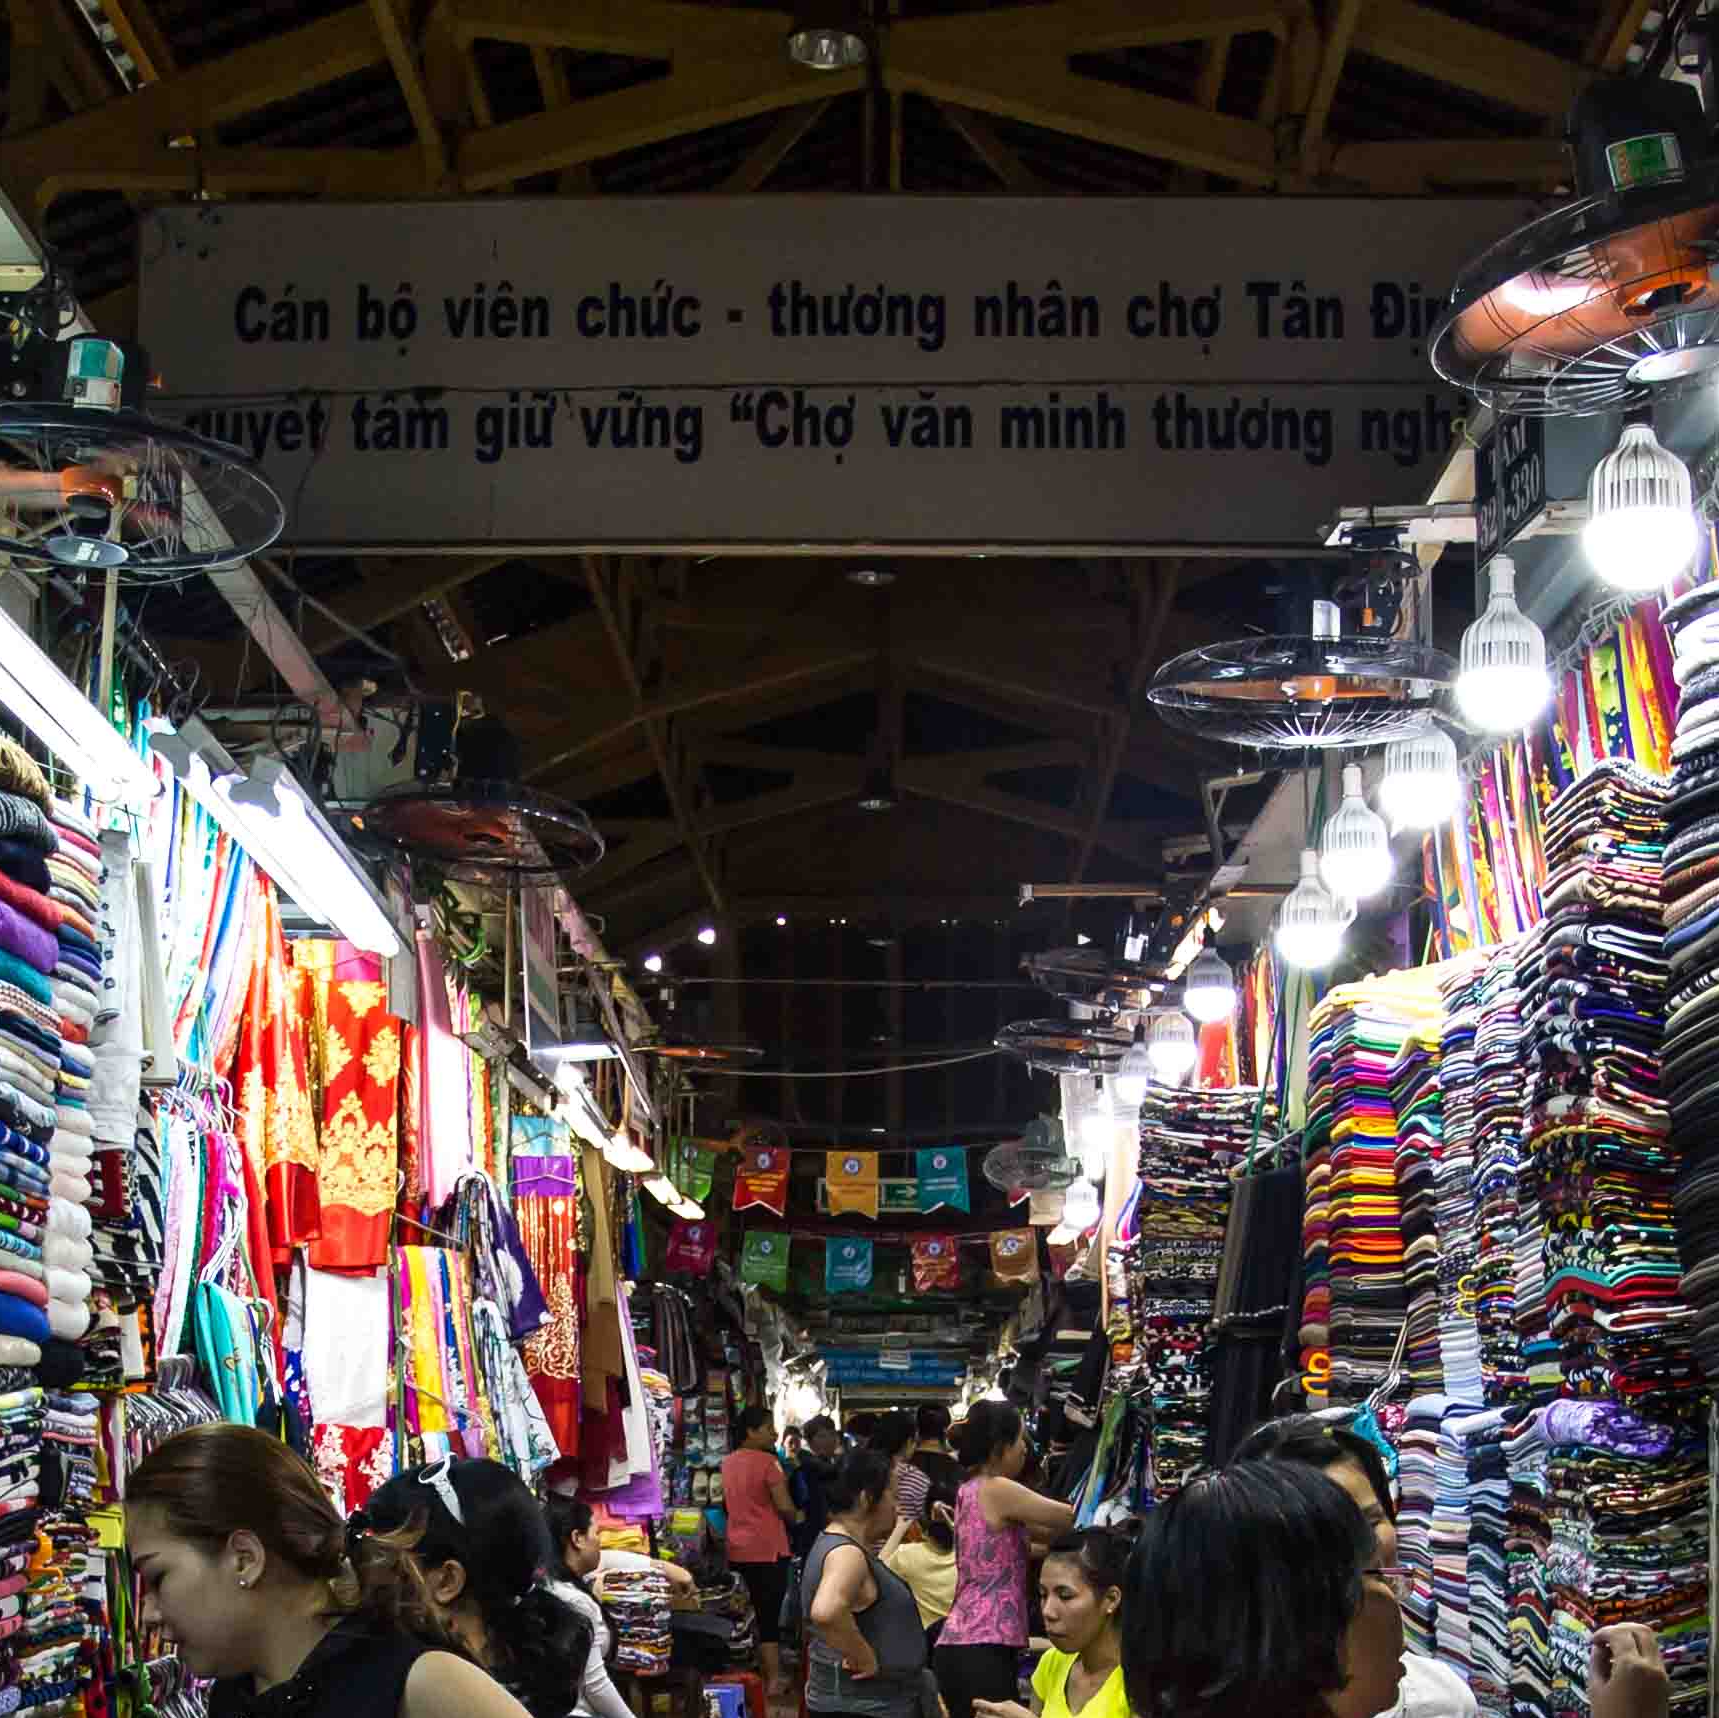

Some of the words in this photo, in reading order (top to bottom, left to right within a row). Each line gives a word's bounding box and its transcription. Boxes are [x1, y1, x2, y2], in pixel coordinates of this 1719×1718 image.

[233, 283, 331, 345] Cán
[357, 282, 418, 357] bộ
[443, 279, 550, 339] viên
[576, 279, 702, 339] chức
[767, 280, 947, 353] thương
[974, 279, 1099, 339] nhân
[1126, 280, 1221, 356] chợ
[1245, 280, 1344, 340] Tân
[580, 391, 703, 463] vững
[880, 390, 973, 449] văn
[1000, 391, 1126, 449] minh
[1151, 391, 1333, 467] thương
